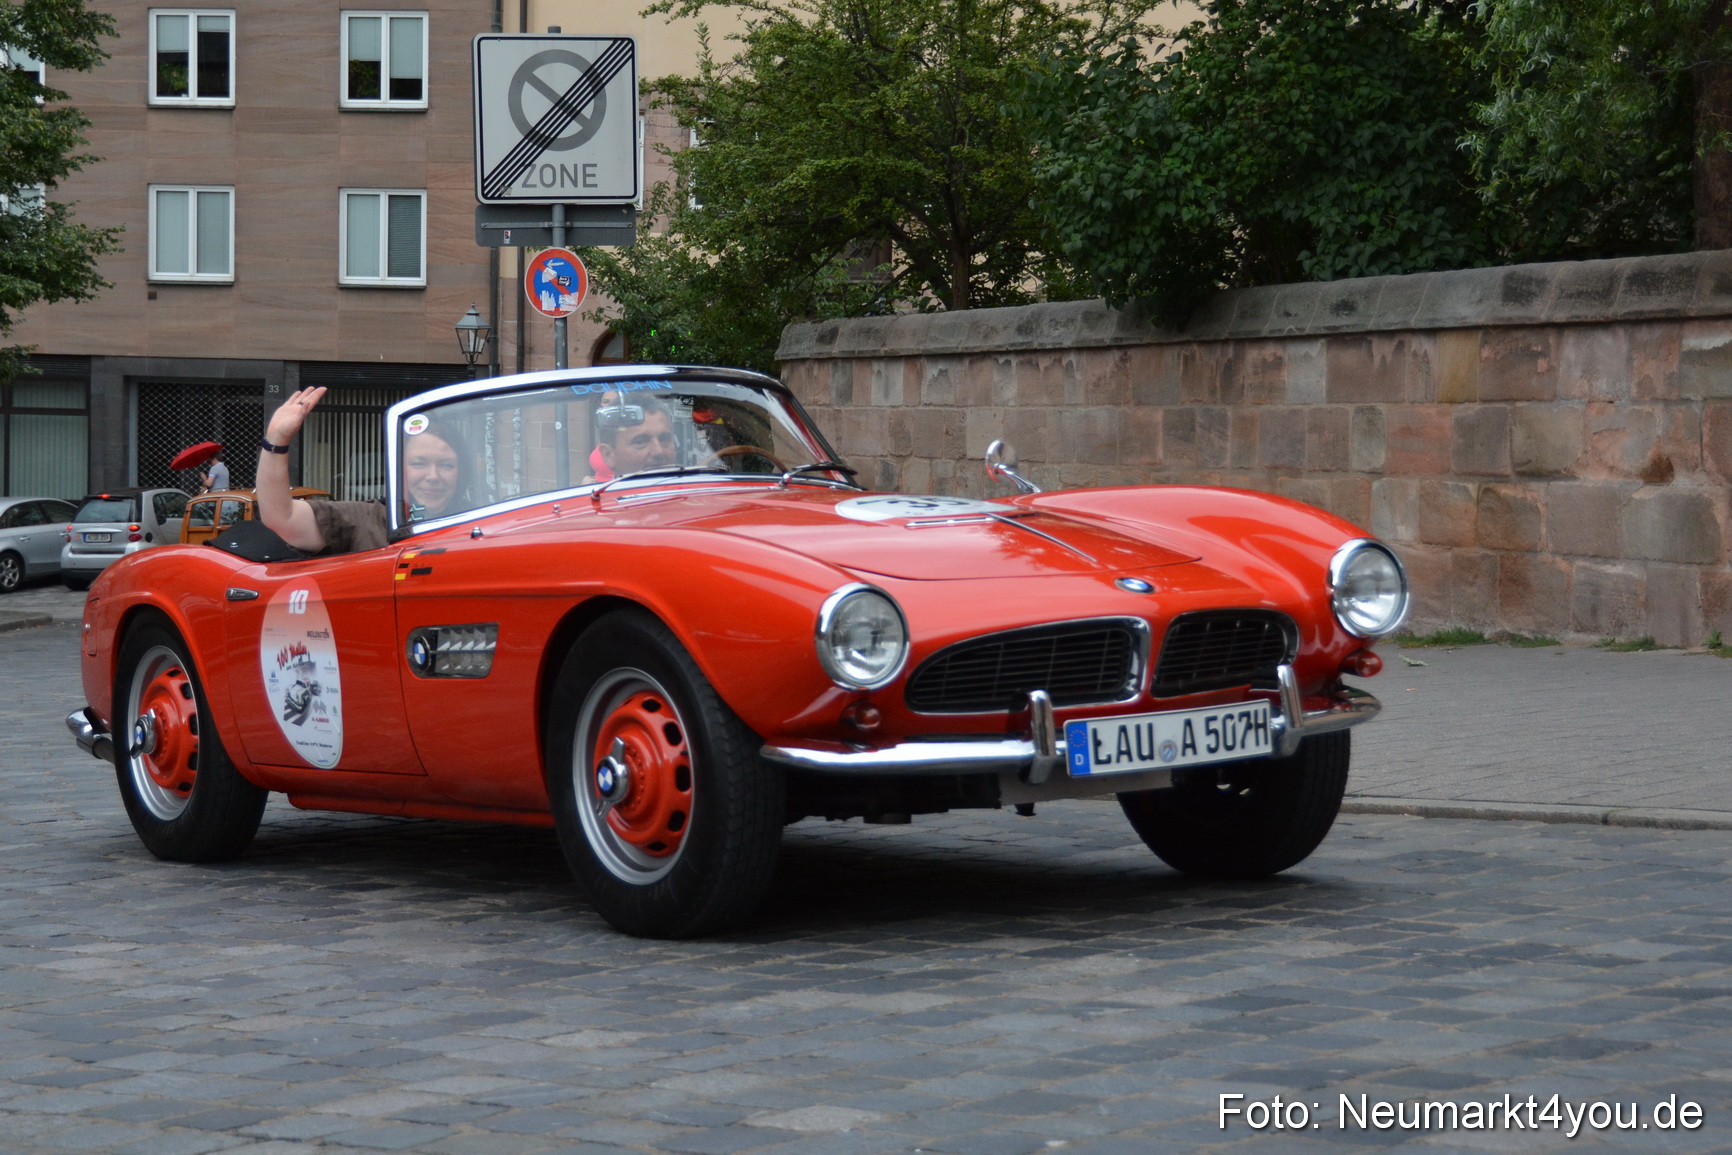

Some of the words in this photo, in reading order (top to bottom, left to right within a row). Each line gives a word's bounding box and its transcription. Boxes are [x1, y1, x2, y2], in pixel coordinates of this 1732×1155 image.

[521, 163, 598, 188] ZONE
[268, 384, 280, 393] 33
[289, 589, 309, 614] 10
[1092, 722, 1154, 765] LAU
[1181, 718, 1197, 757] A
[1205, 707, 1269, 754] 507H
[1075, 753, 1084, 765] D
